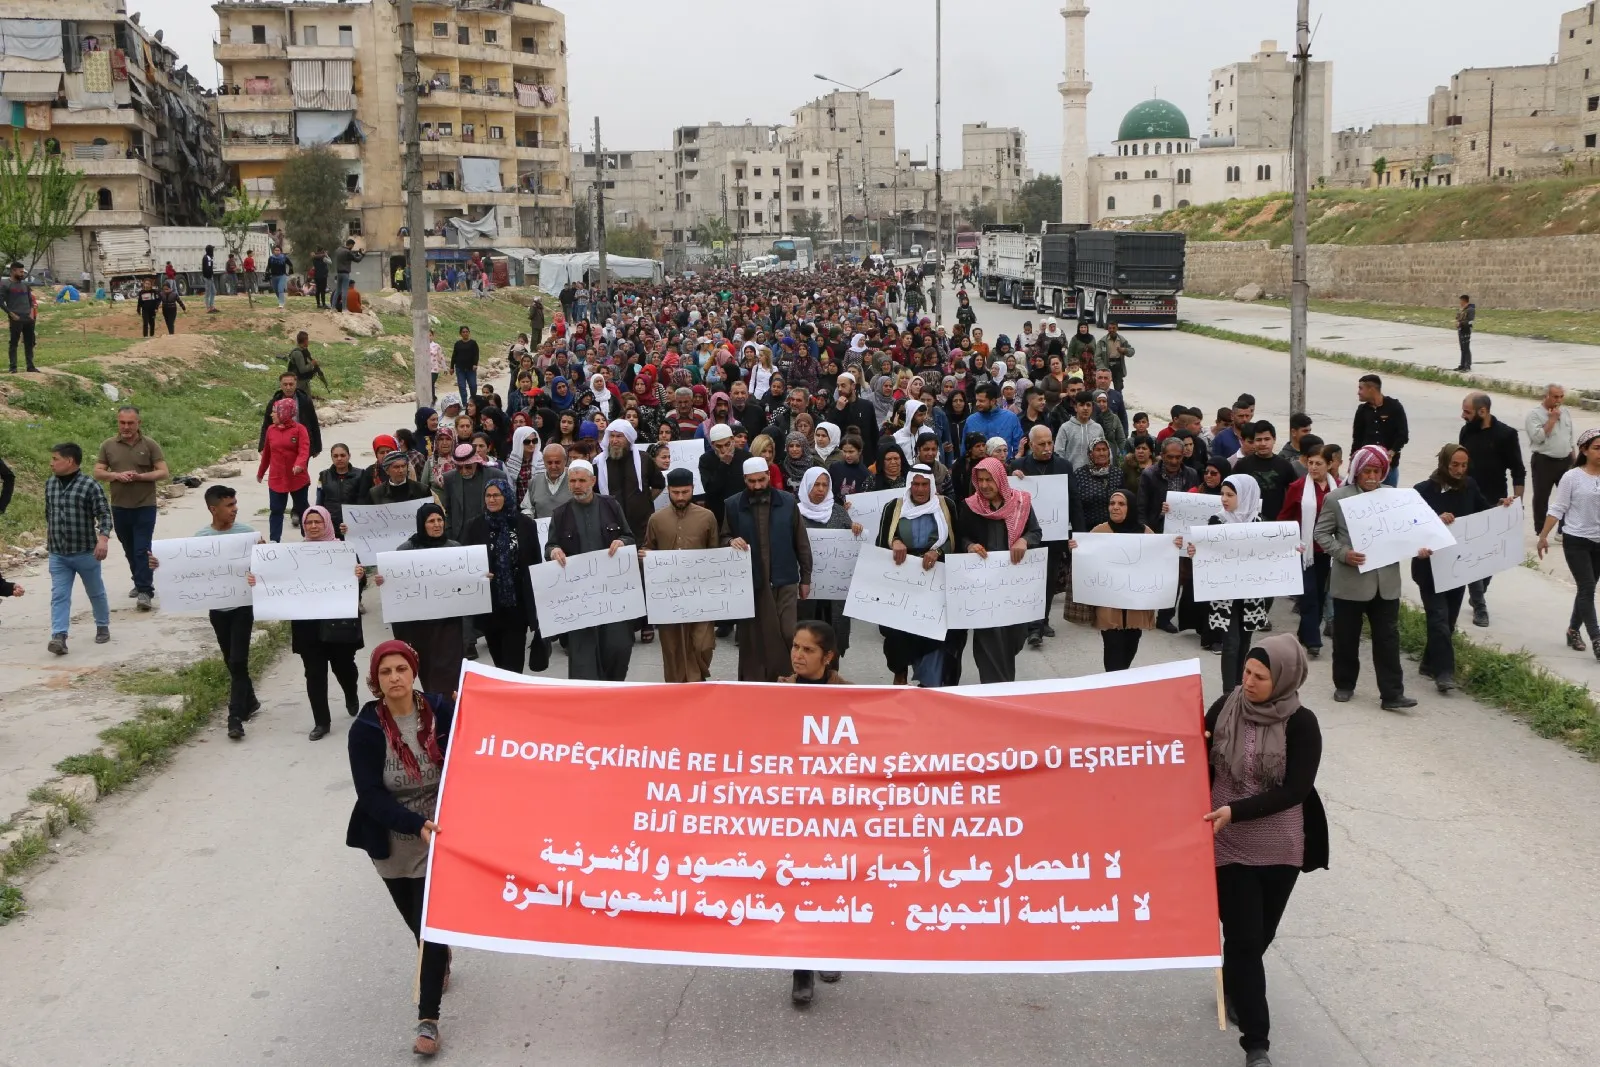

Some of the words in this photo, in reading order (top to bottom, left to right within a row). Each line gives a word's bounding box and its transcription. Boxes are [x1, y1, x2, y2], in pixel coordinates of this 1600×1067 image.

[1496, 508, 1519, 536] لا
[256, 547, 280, 562] Na
[607, 552, 632, 579] لا
[1105, 536, 1143, 566] لا
[547, 557, 599, 589] للحصار
[611, 582, 636, 595] على
[803, 716, 859, 744] NA
[687, 753, 716, 772] RE
[749, 755, 793, 774] SER
[799, 753, 876, 775] TAXÊN
[883, 748, 1038, 778] ŞÊXMEQSÛD
[1045, 745, 1061, 768] Û
[647, 782, 682, 802] NA
[971, 785, 1000, 804] RE
[683, 814, 857, 837] BERXWEDANA
[864, 813, 944, 837] GELÊN
[951, 817, 1023, 837] AZAD
[540, 838, 649, 874] الأشرفية
[652, 855, 669, 881] و
[677, 852, 767, 883] مقصود
[776, 853, 856, 886] الشيخ
[865, 847, 931, 888] أحياء
[998, 852, 1090, 888] للحصار
[1104, 850, 1121, 878] لا
[939, 855, 992, 888] على
[503, 875, 573, 910] الحرة
[580, 888, 687, 917] الشعوب
[1133, 892, 1150, 920] لا
[694, 891, 785, 926] مقاومة
[795, 895, 873, 923] عاشت
[906, 896, 1010, 931] التجويع
[1018, 894, 1118, 930] لسياسة
